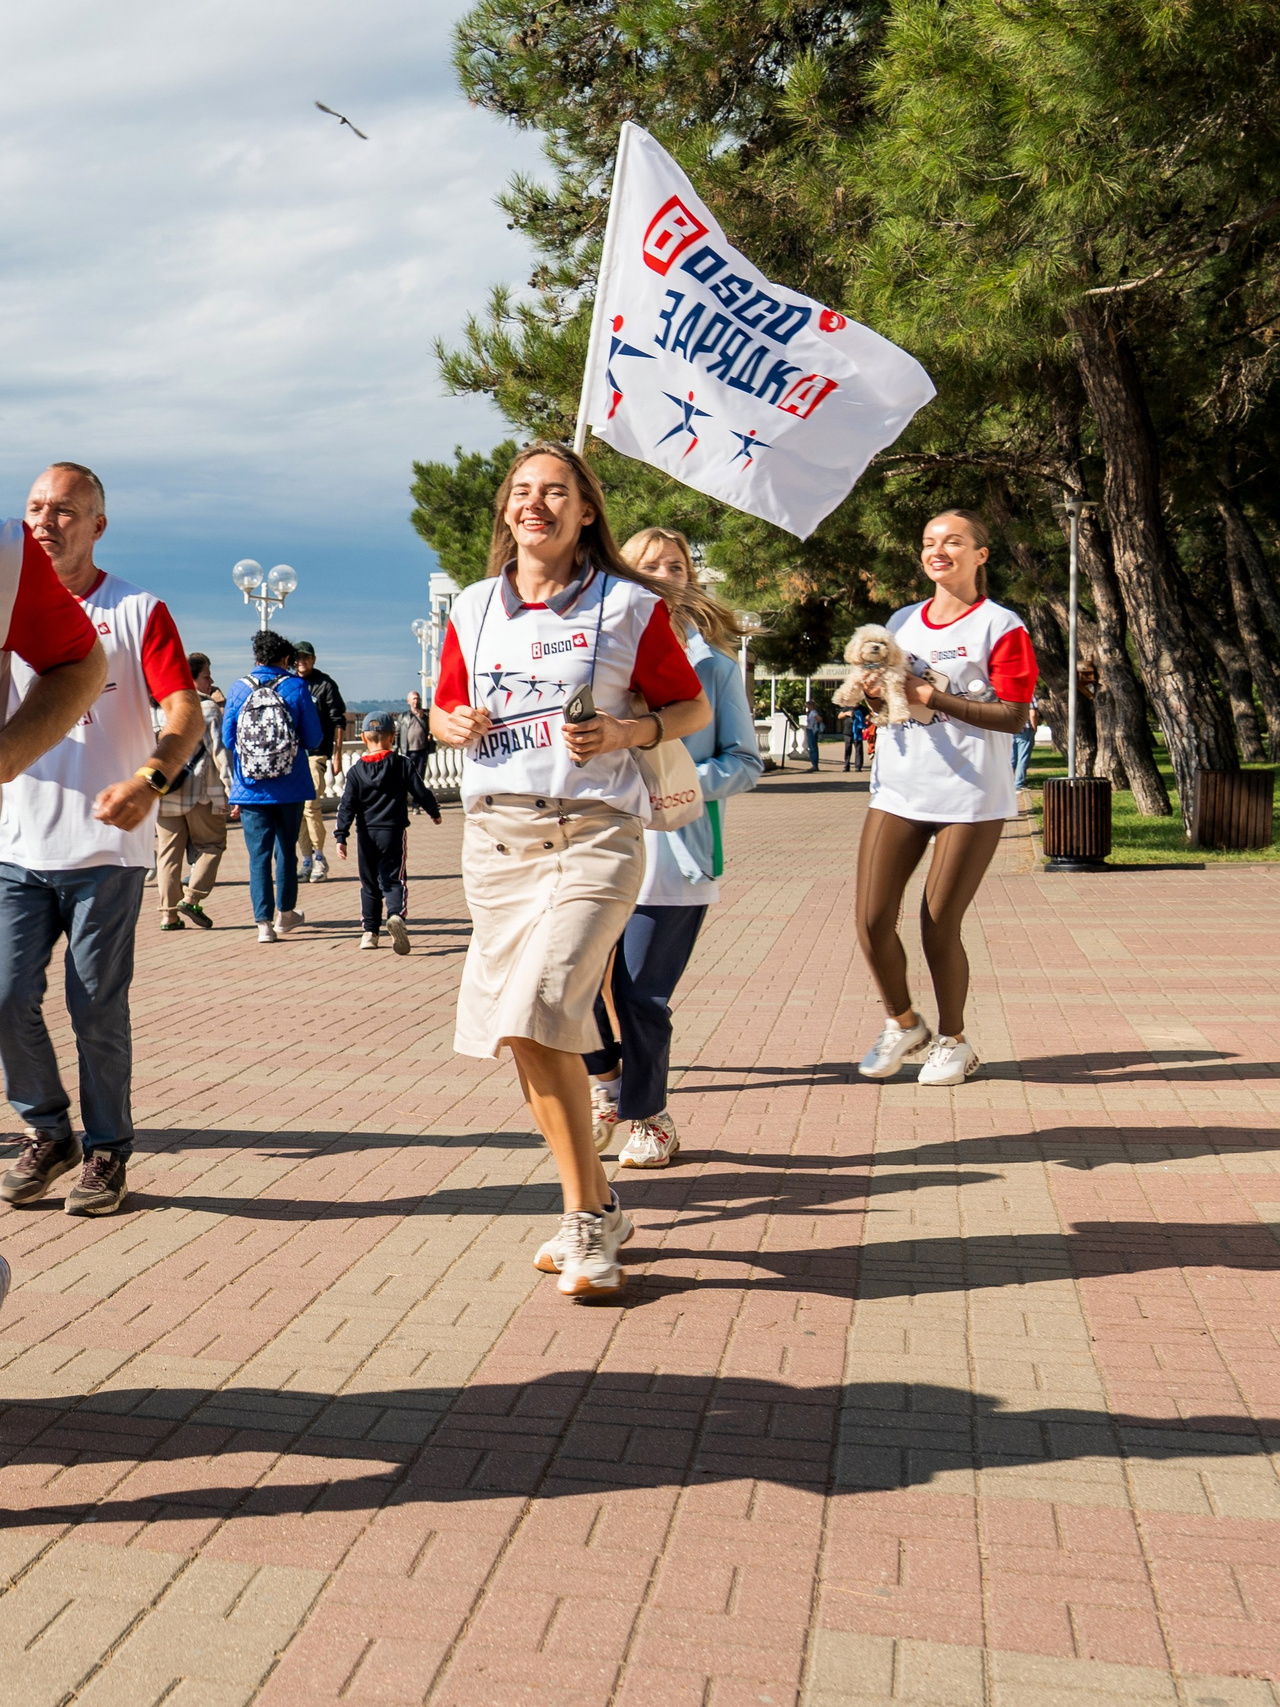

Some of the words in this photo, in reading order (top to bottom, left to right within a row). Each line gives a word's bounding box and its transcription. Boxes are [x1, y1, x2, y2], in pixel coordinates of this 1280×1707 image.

[642, 194, 812, 345] BOSCO
[654, 288, 840, 420] ЗАРЯДКА
[531, 639, 572, 660] BOSCO
[826, 668, 850, 676] КОМП
[654, 789, 696, 811] BOSCO
